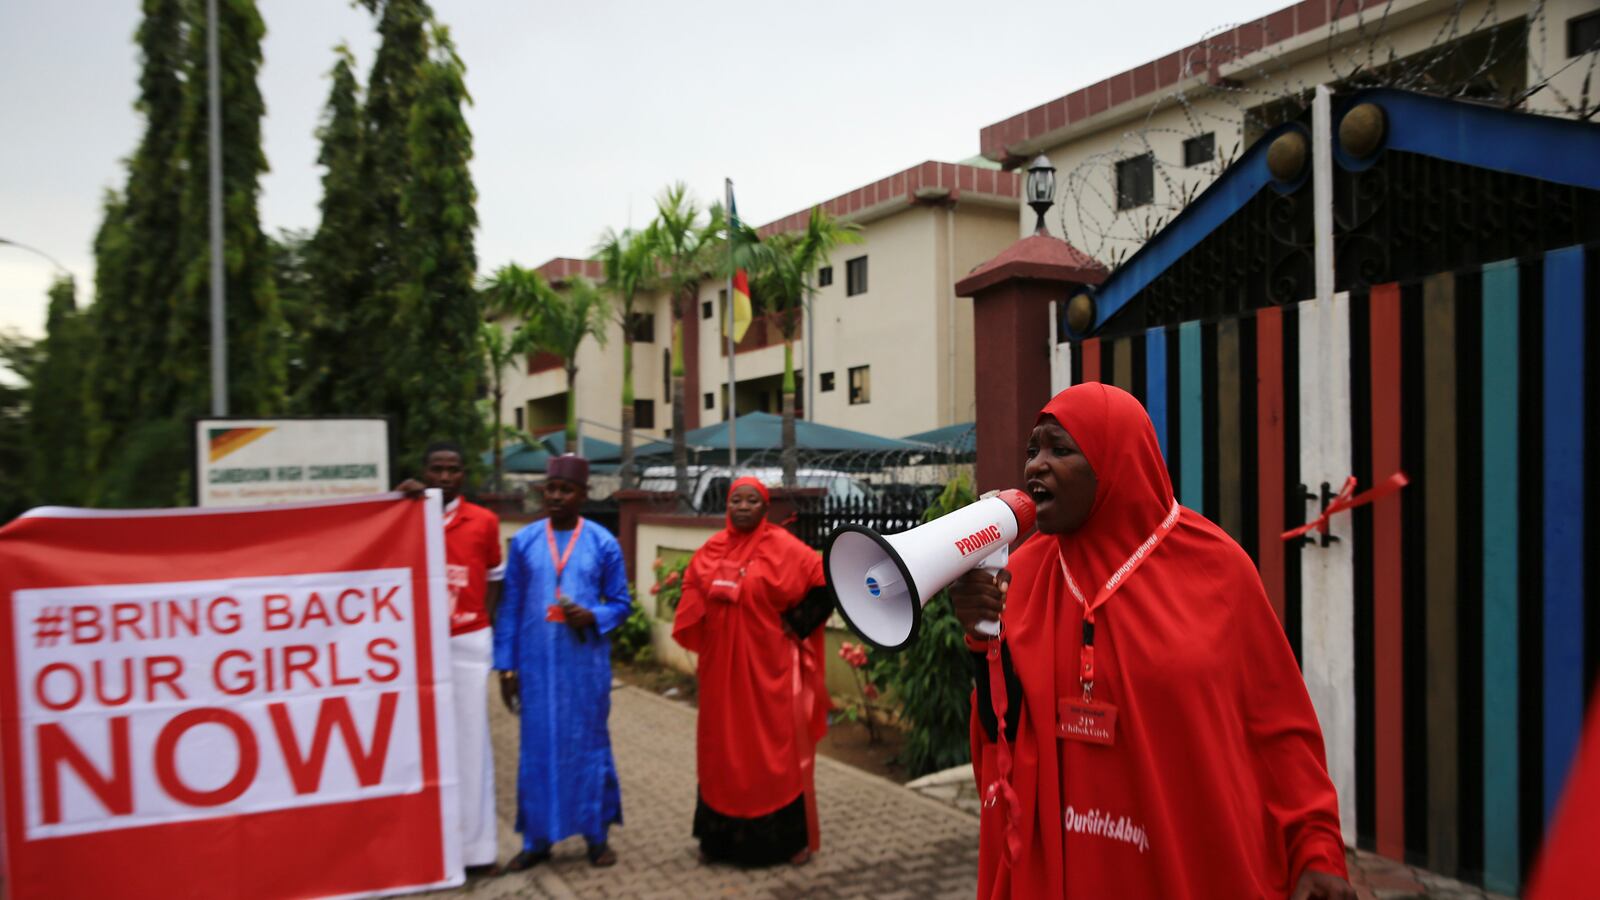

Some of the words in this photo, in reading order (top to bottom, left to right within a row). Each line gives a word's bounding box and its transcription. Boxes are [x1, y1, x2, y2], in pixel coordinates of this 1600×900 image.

[955, 525, 1001, 556] PROMIC
[35, 595, 242, 648] #BRING
[264, 586, 403, 632] BACK
[36, 655, 187, 712] OUR
[213, 637, 402, 697] GIRLS
[36, 691, 400, 825] NOW
